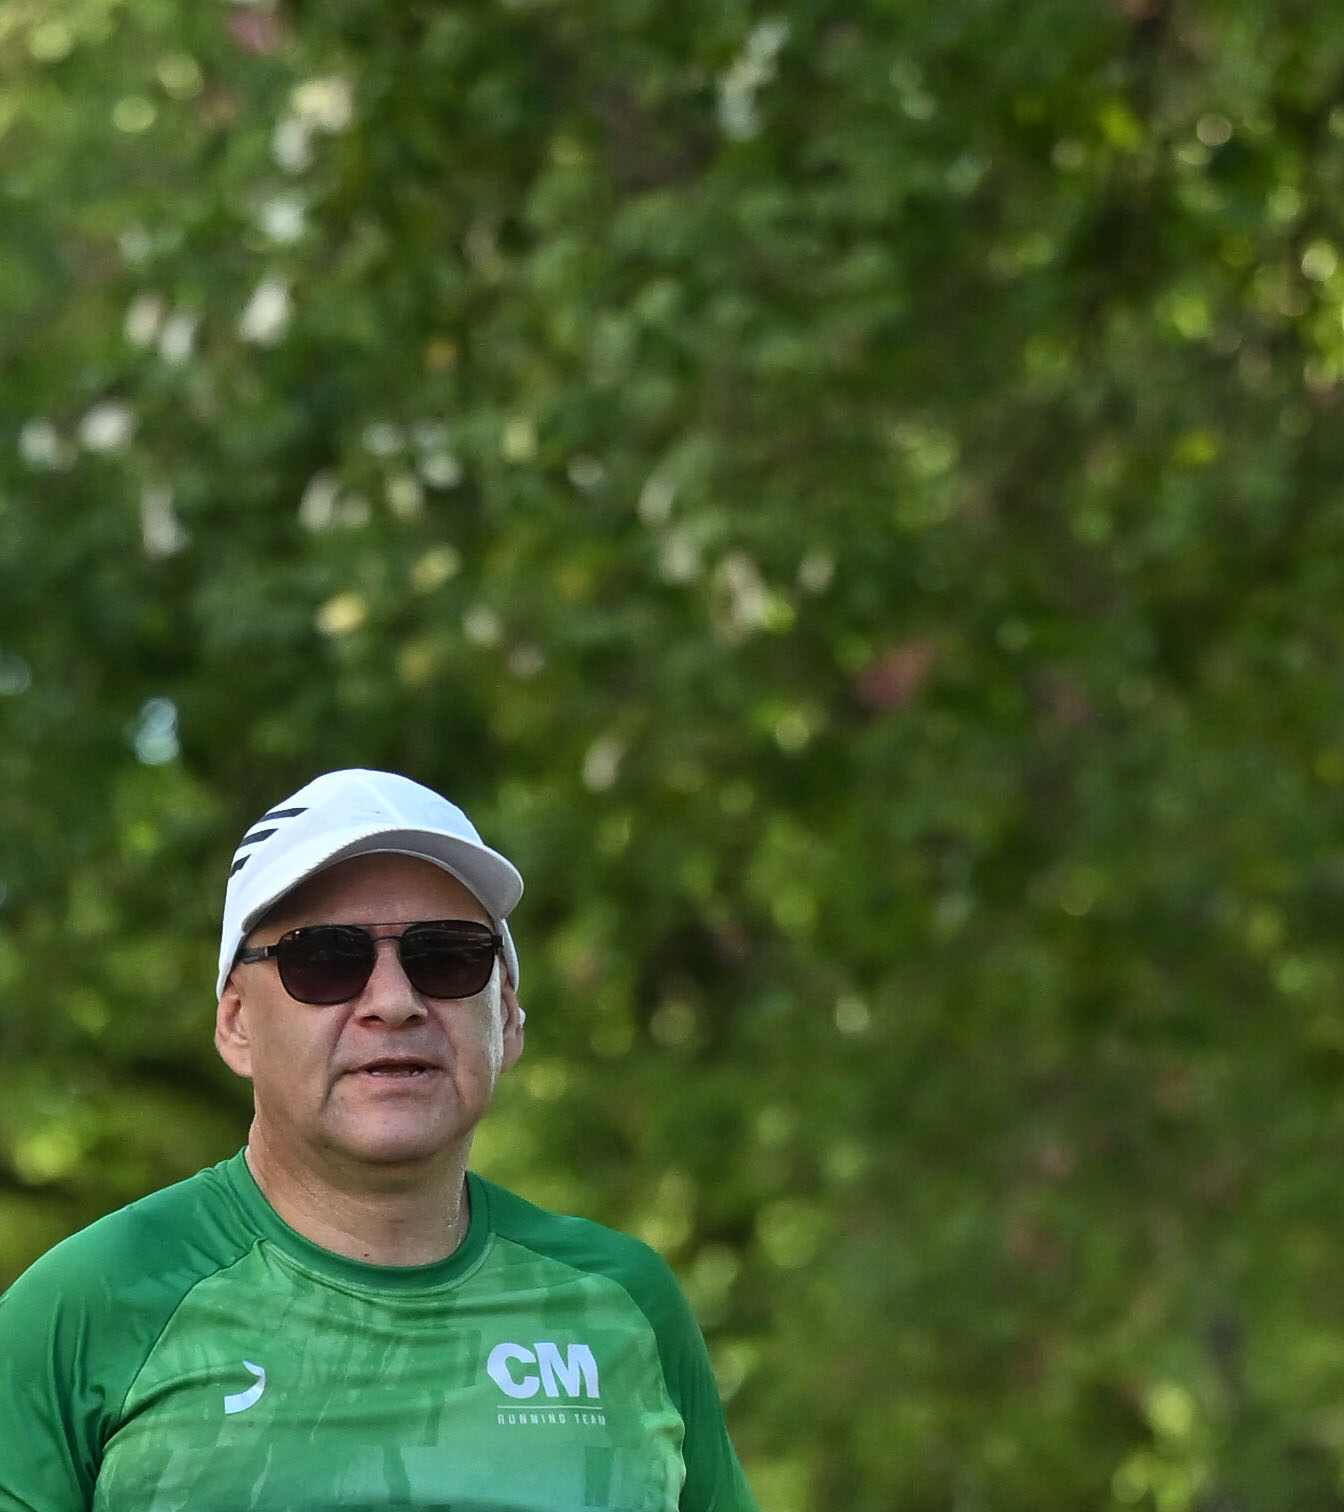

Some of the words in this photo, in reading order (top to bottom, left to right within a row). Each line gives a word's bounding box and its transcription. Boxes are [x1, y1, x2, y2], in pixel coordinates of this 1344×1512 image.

[486, 1342, 600, 1399] CM
[497, 1413, 566, 1425] RUNNING
[574, 1413, 606, 1426] TEAM
